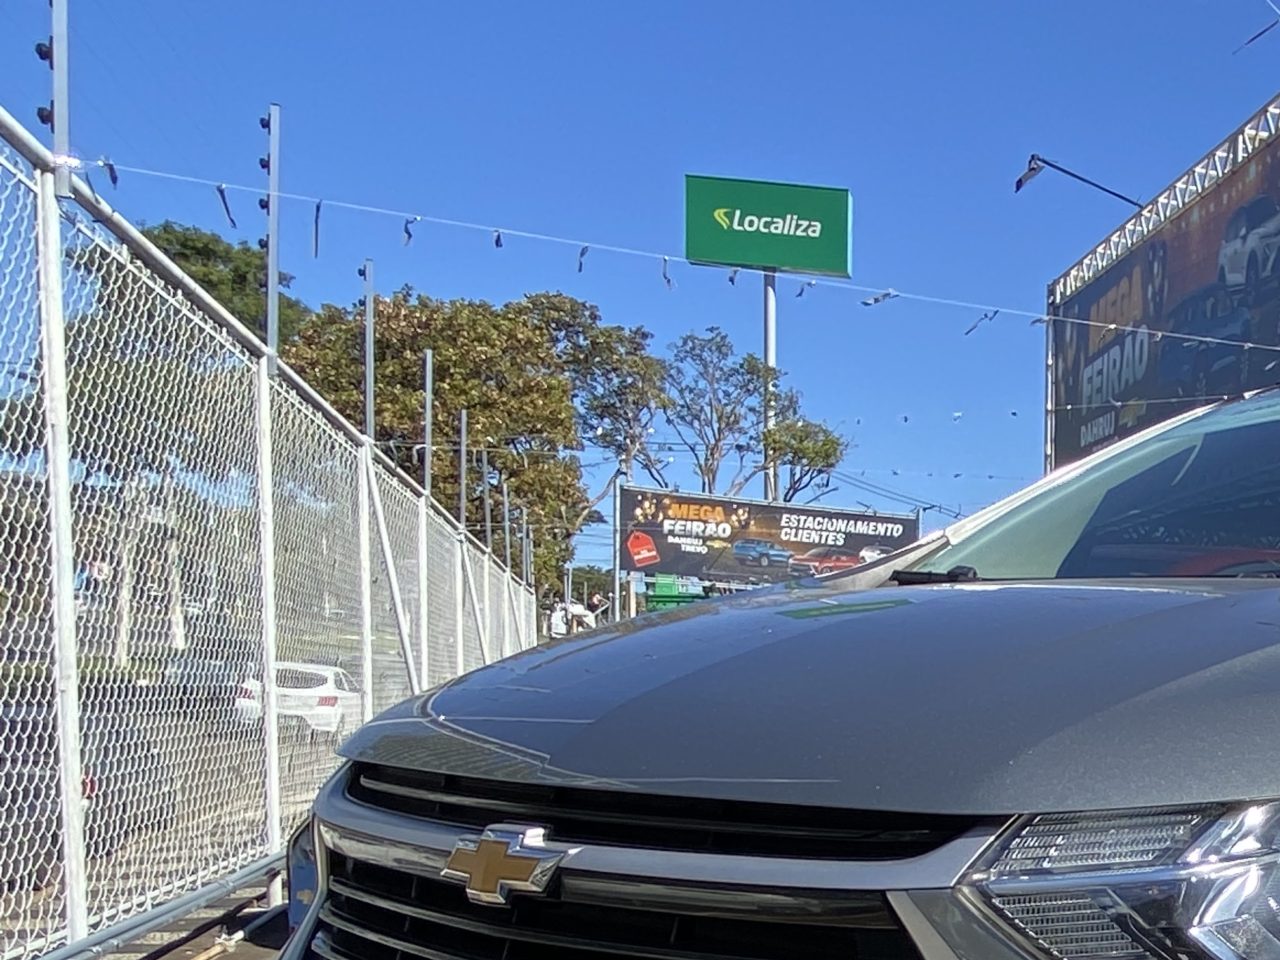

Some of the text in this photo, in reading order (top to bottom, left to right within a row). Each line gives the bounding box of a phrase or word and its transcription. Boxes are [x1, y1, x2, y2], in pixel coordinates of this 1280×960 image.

[732, 209, 822, 238] Localiza
[1088, 265, 1144, 359] MEGA
[1081, 321, 1149, 417] FEIRÃO
[1080, 410, 1115, 448] DAHRUJ
[671, 503, 725, 522] MEGA
[780, 513, 904, 538] ESTACIONAMENTO
[780, 527, 846, 546] CLIENTES
